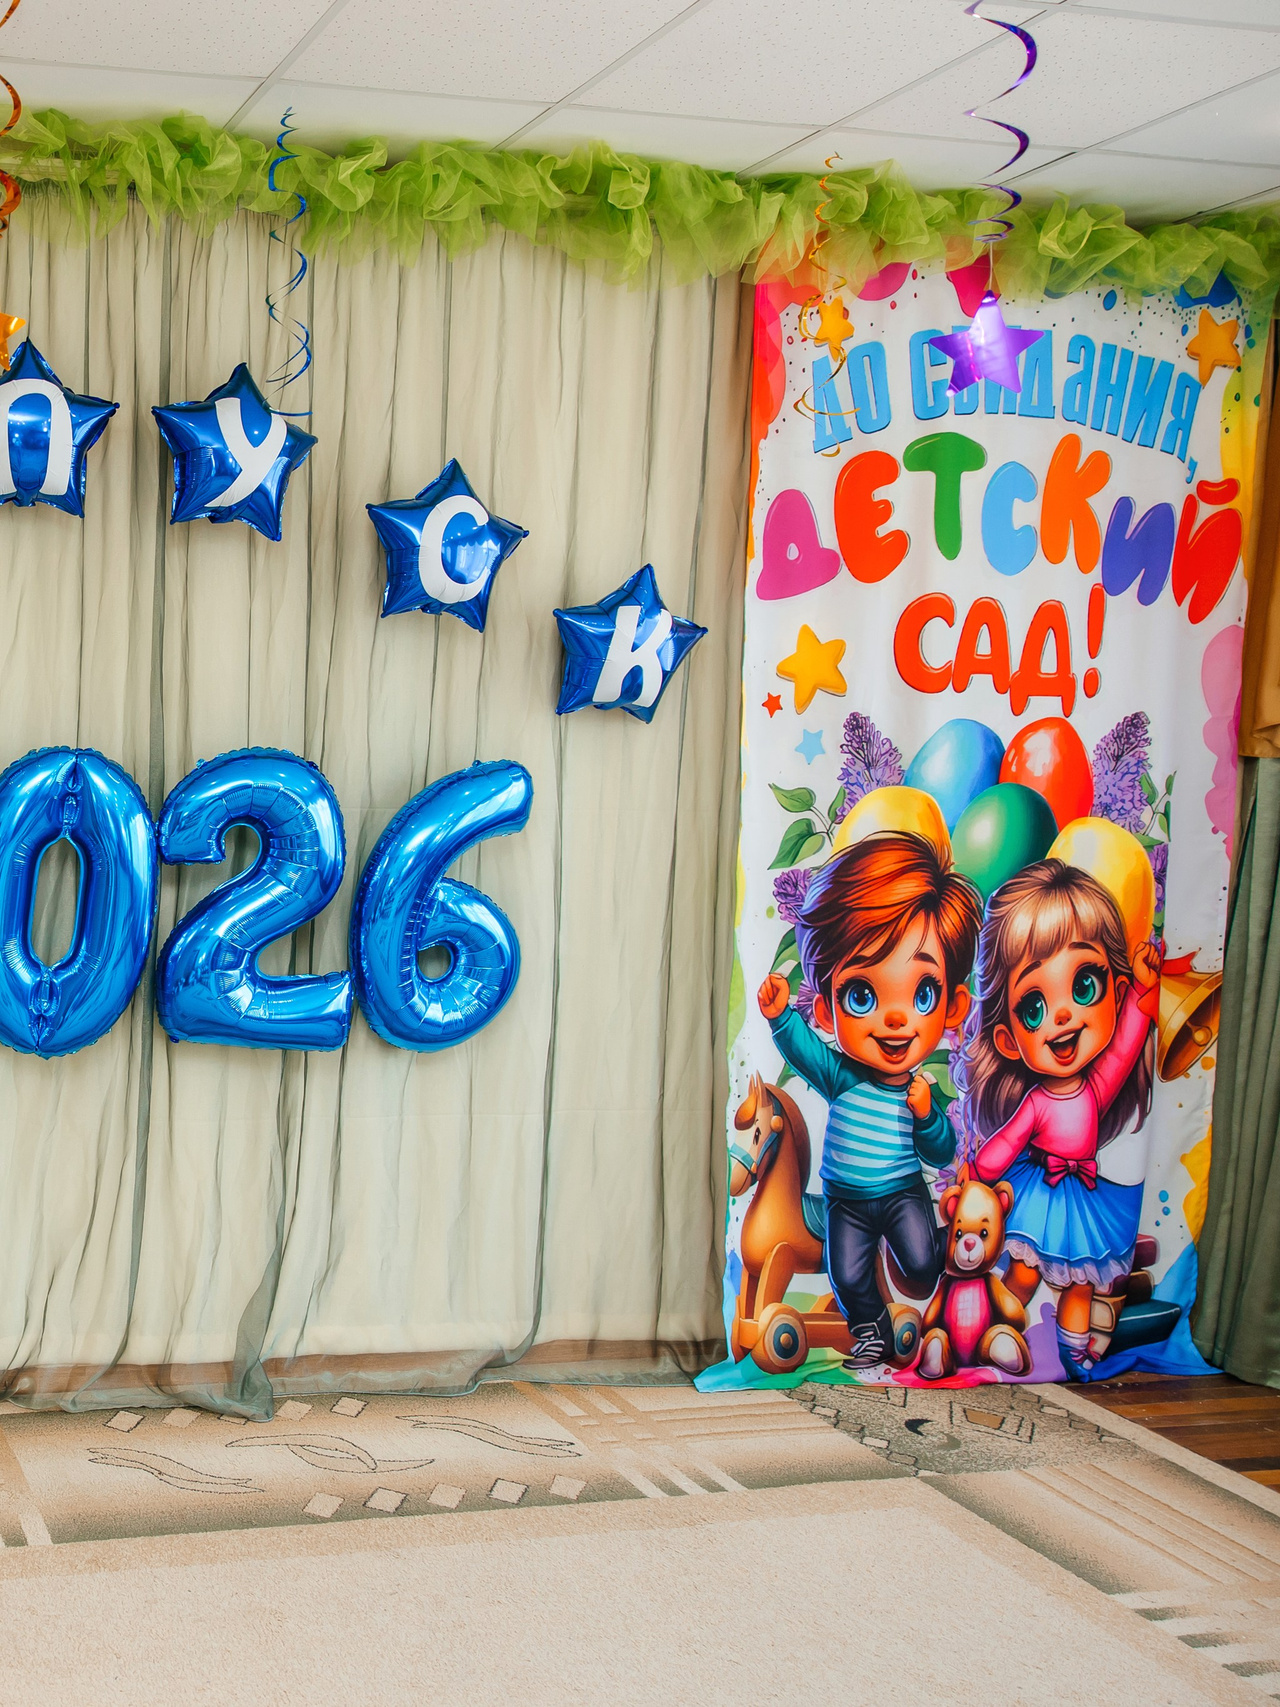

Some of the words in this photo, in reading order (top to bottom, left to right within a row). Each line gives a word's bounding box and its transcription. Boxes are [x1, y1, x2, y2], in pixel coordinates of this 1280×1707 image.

[813, 342, 892, 454] ДО
[756, 431, 1244, 625] ДЕТСКИЙ
[893, 583, 1107, 717] САД!
